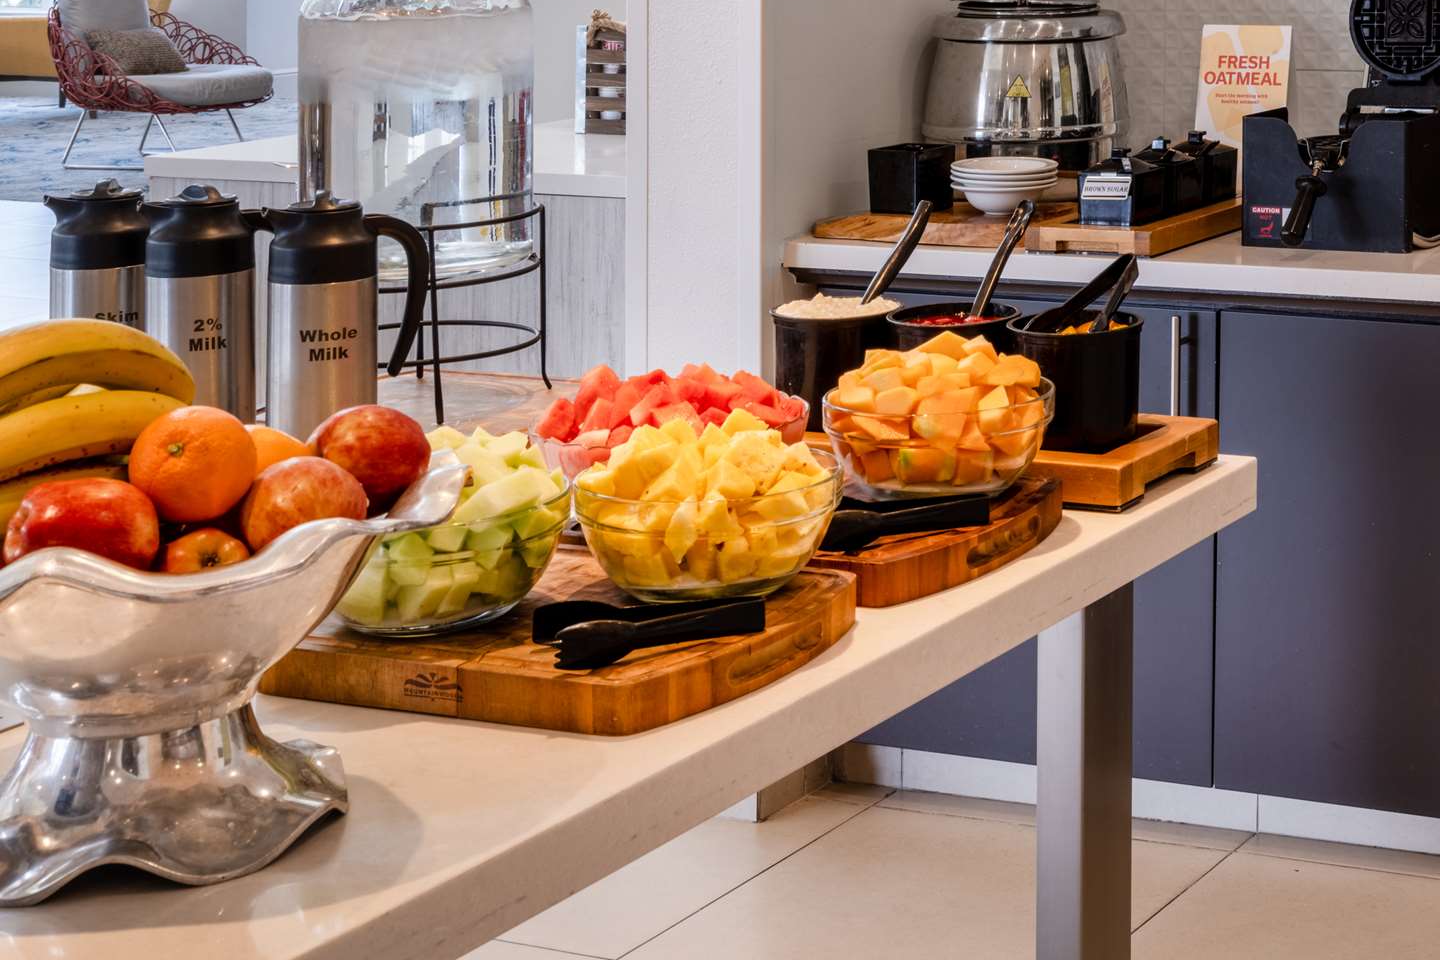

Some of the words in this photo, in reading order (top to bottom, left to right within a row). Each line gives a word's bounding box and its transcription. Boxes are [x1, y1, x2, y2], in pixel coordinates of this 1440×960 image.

[1217, 55, 1271, 69] FRESH
[1203, 71, 1282, 86] OATMEAL
[95, 310, 139, 323] Skim
[193, 318, 223, 332] 2%
[299, 327, 358, 343] Whole
[188, 336, 228, 352] Milk
[308, 346, 349, 362] Milk
